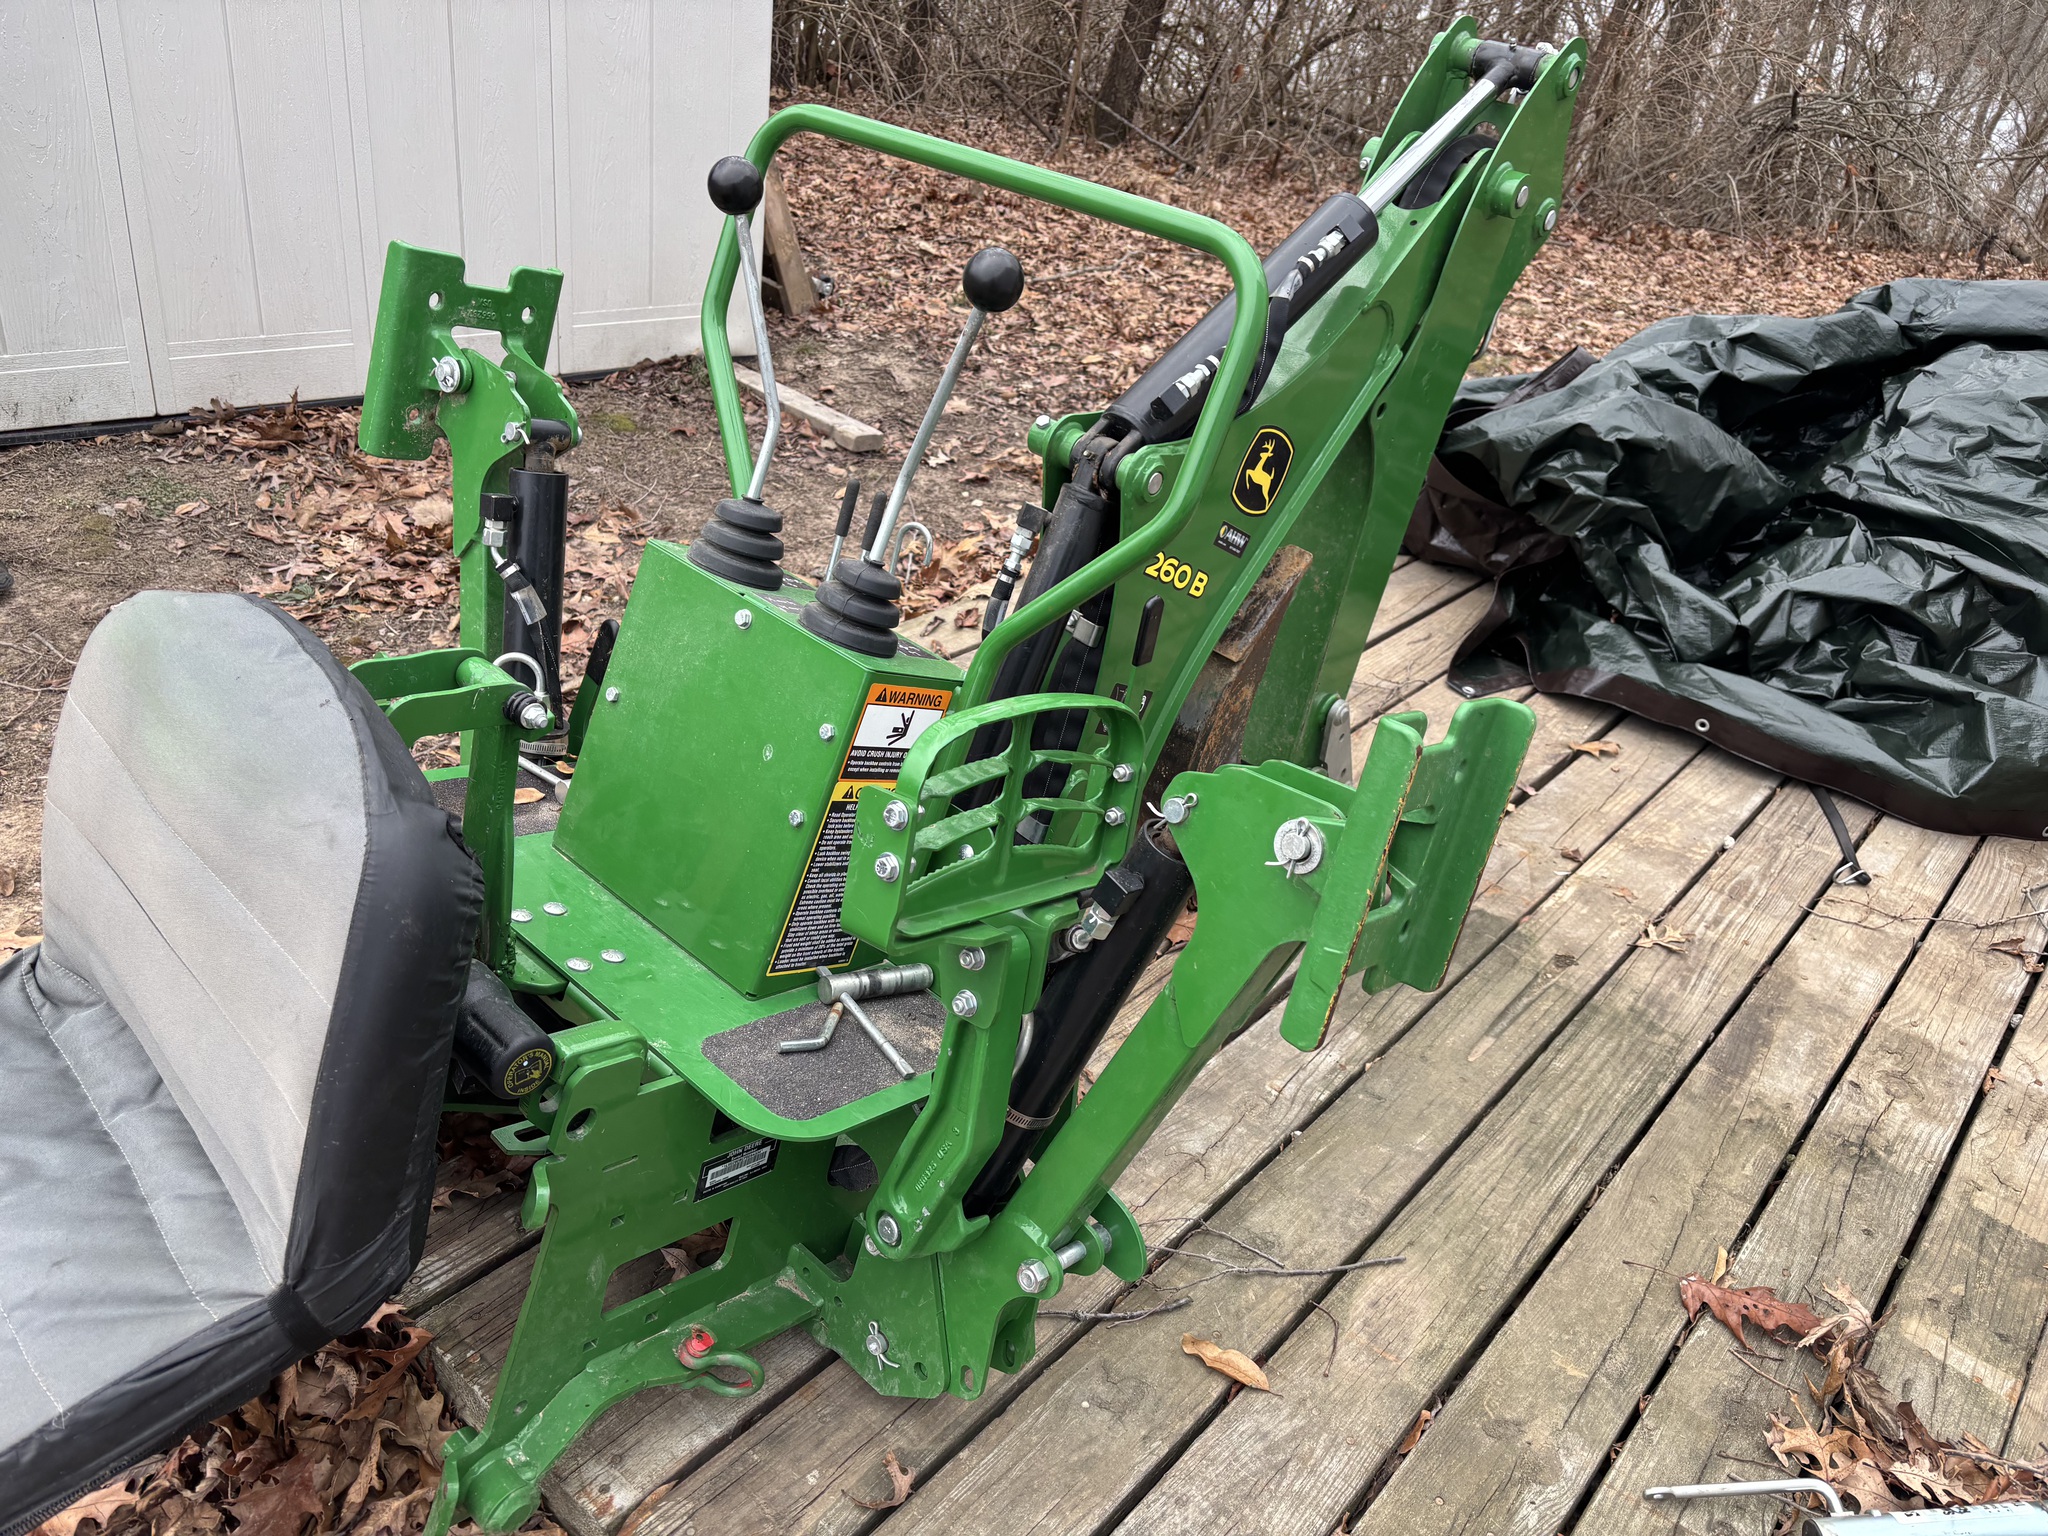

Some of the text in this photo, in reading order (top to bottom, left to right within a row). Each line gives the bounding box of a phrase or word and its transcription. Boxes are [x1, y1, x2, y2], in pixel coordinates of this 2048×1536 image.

[889, 690, 943, 708] WARNING
[867, 750, 885, 758] CRUSH
[507, 1051, 550, 1089] OPERATOR'S MANUAL
[517, 1079, 541, 1093] INSIDE
[727, 1140, 763, 1158] JOHN DEERE
[936, 1140, 953, 1159] USA
